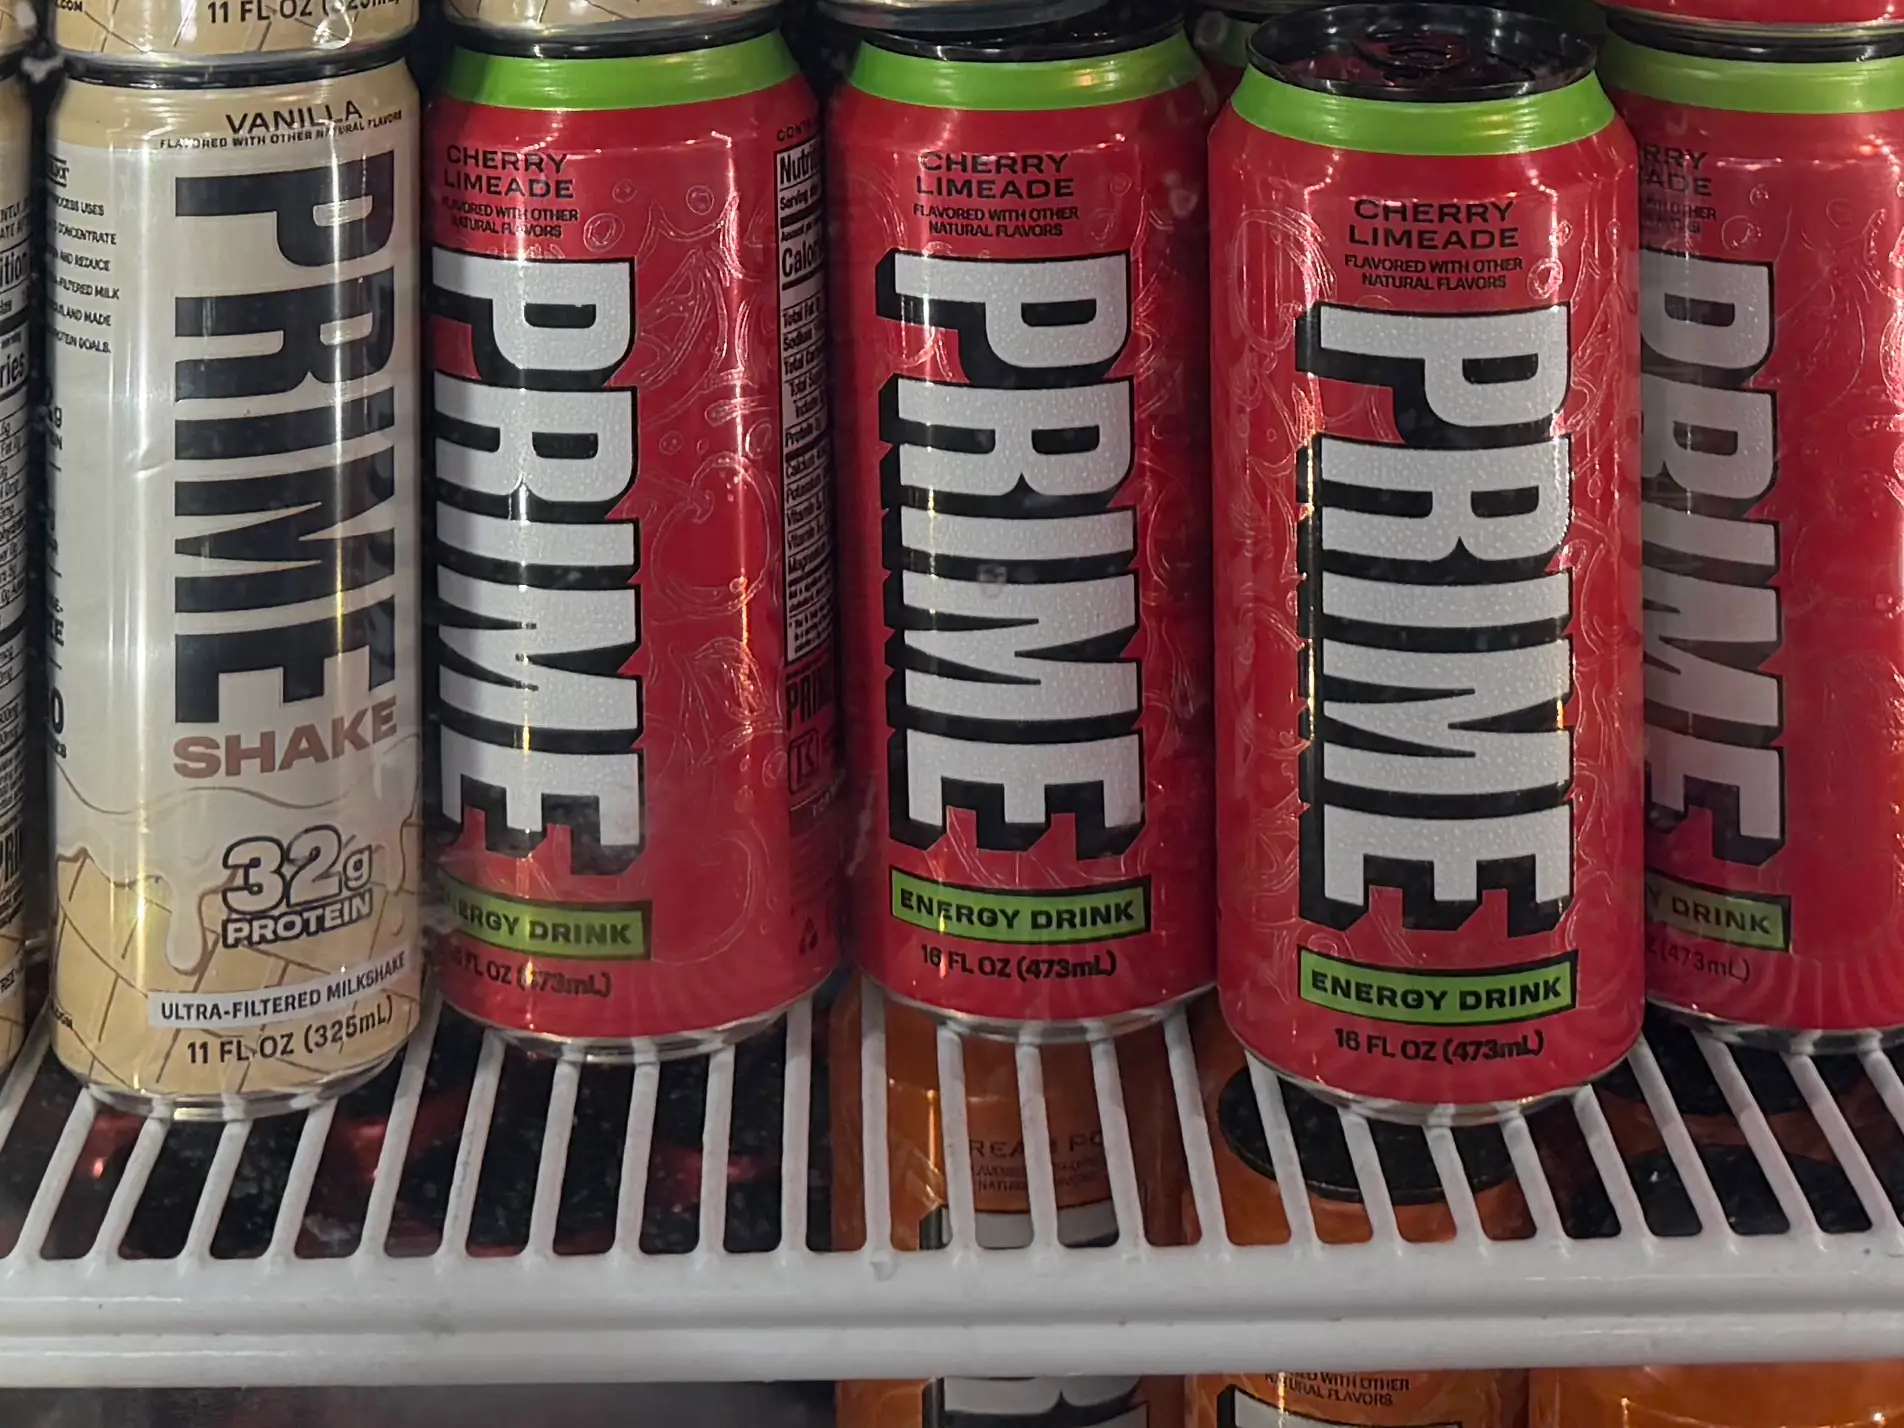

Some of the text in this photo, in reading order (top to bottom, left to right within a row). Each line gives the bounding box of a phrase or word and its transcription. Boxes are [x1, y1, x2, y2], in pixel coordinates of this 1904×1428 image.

[226, 100, 364, 133] VANILLA
[920, 152, 1071, 176] CHERRY
[915, 175, 1076, 200] LIMEADE
[1353, 198, 1515, 225] CHERRY
[1347, 223, 1520, 250] LIMEADE
[1342, 253, 1524, 272] FLAVORED WITH OTHER
[1360, 272, 1507, 291] NATURAL FLAVORS
[174, 150, 395, 724] PRIME
[881, 249, 1148, 860] PRIME
[1299, 302, 1576, 931] PRIME
[172, 696, 397, 779] SHAKE
[222, 824, 372, 917] 32g
[221, 892, 372, 948] PROTEIN
[899, 887, 1135, 931] ENERGY DRINK
[159, 950, 406, 1023] ULTRA-FILTERED MILKSHAKE
[1310, 969, 1562, 1013] ENERGY DRINK
[186, 1002, 394, 1065] 11 FL OZ (325mL)
[1334, 1027, 1545, 1065] 16 FL OZ (473mL)
